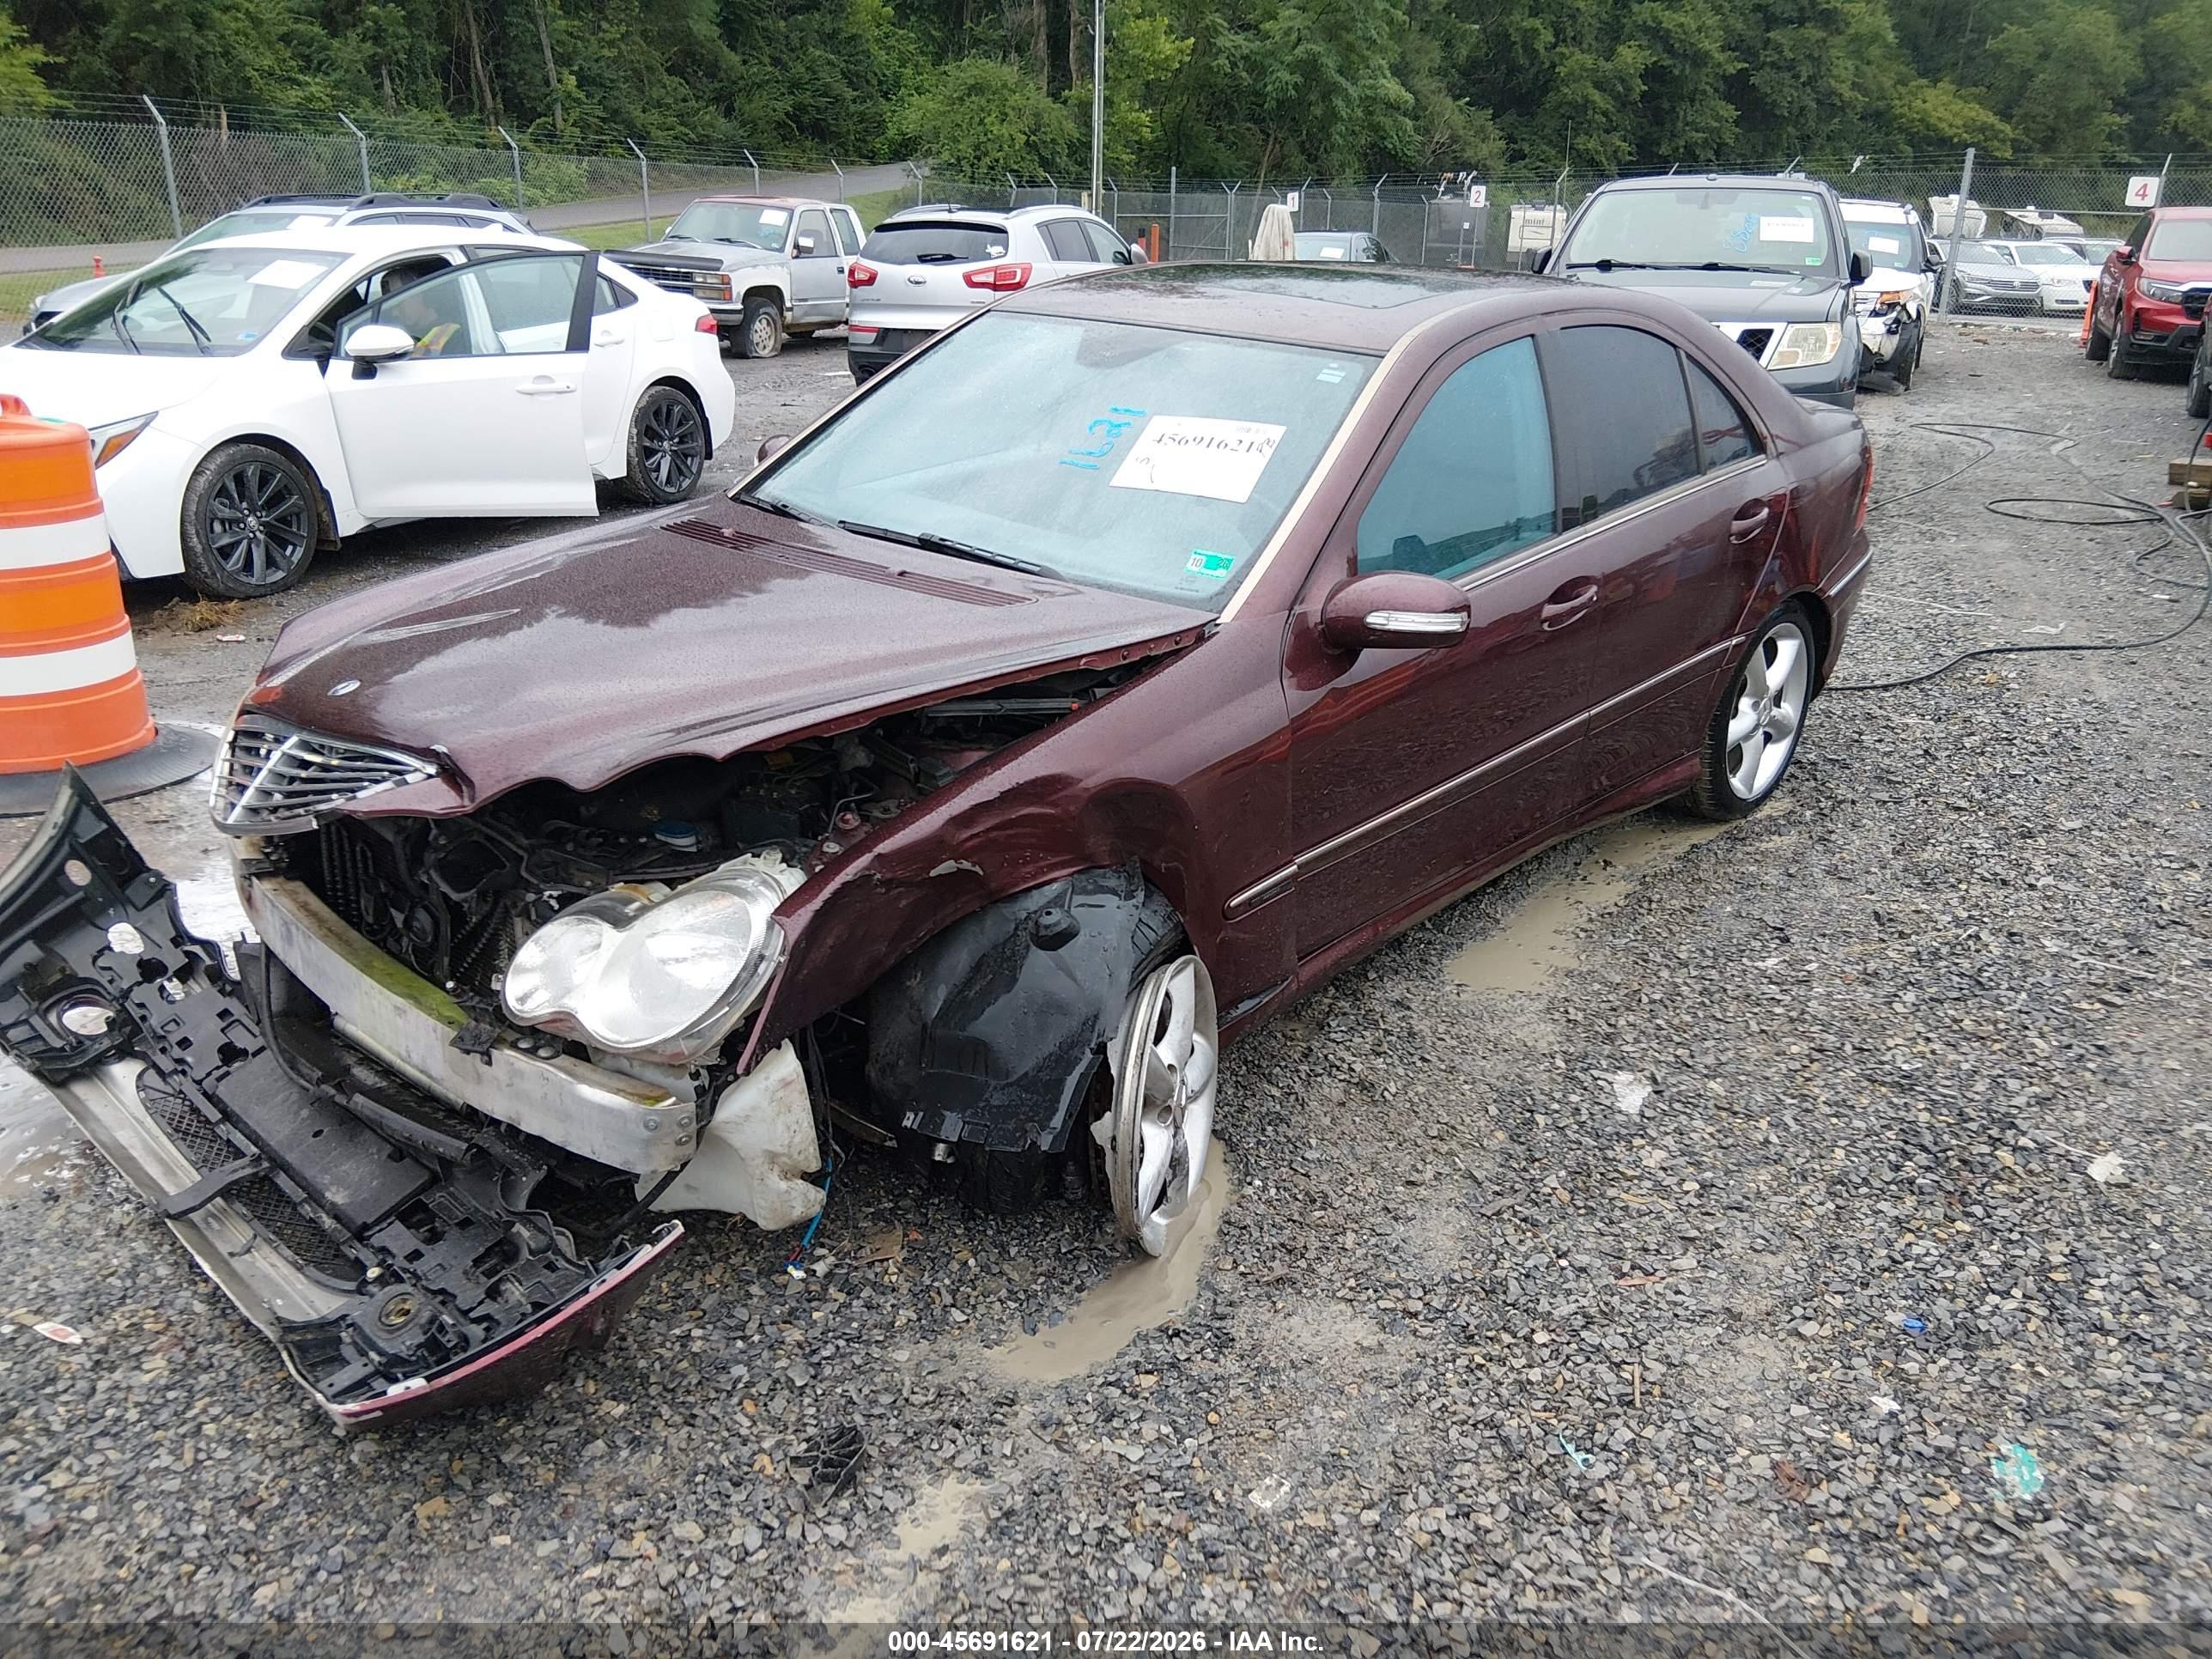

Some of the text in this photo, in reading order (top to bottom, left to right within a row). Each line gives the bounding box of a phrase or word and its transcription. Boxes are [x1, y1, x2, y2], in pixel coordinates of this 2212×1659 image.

[1474, 190, 1482, 204] 2
[2134, 182, 2149, 202] 4
[1152, 432, 1255, 453] 45691621
[1190, 556, 1204, 568] 10
